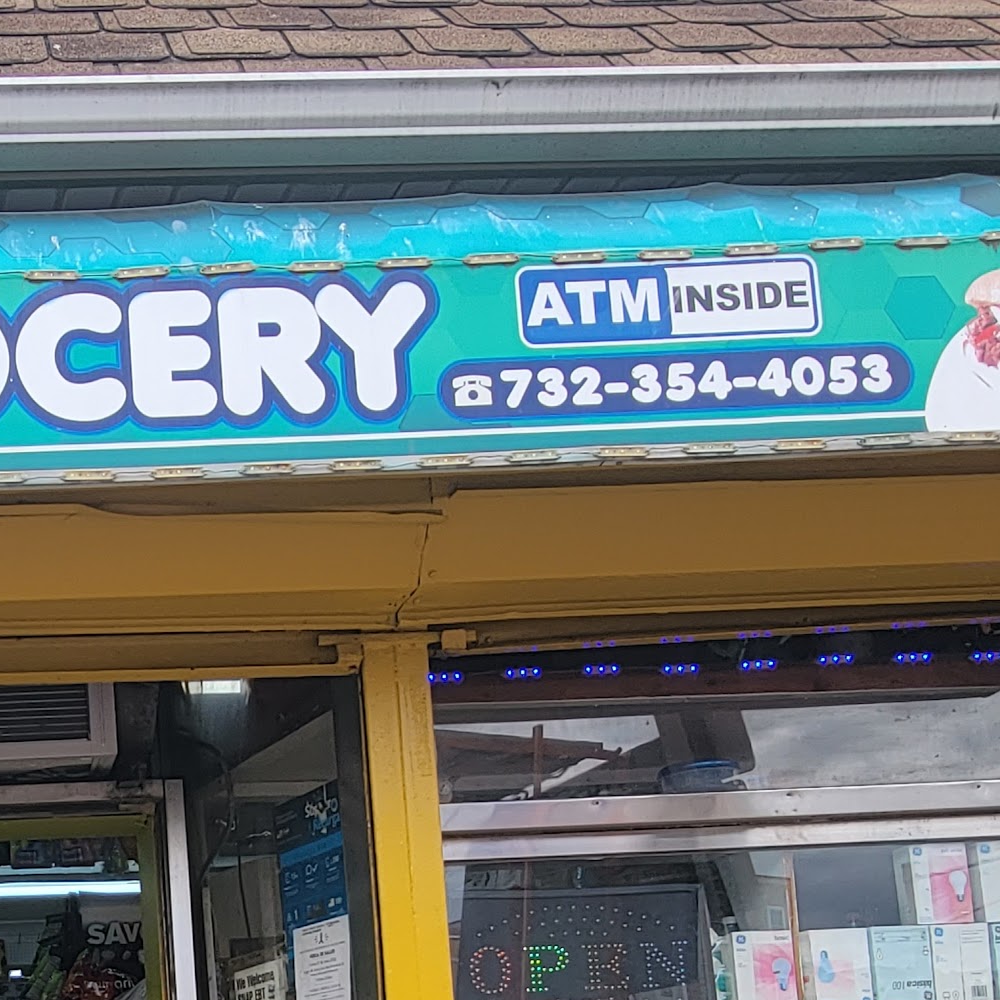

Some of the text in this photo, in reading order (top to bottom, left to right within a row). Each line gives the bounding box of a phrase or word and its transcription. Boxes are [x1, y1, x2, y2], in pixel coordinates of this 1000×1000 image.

[526, 276, 811, 327] ATM INSIDE
[499, 353, 894, 409] 732-354-4053
[86, 920, 142, 945] SAV
[247, 970, 275, 988] Welcome
